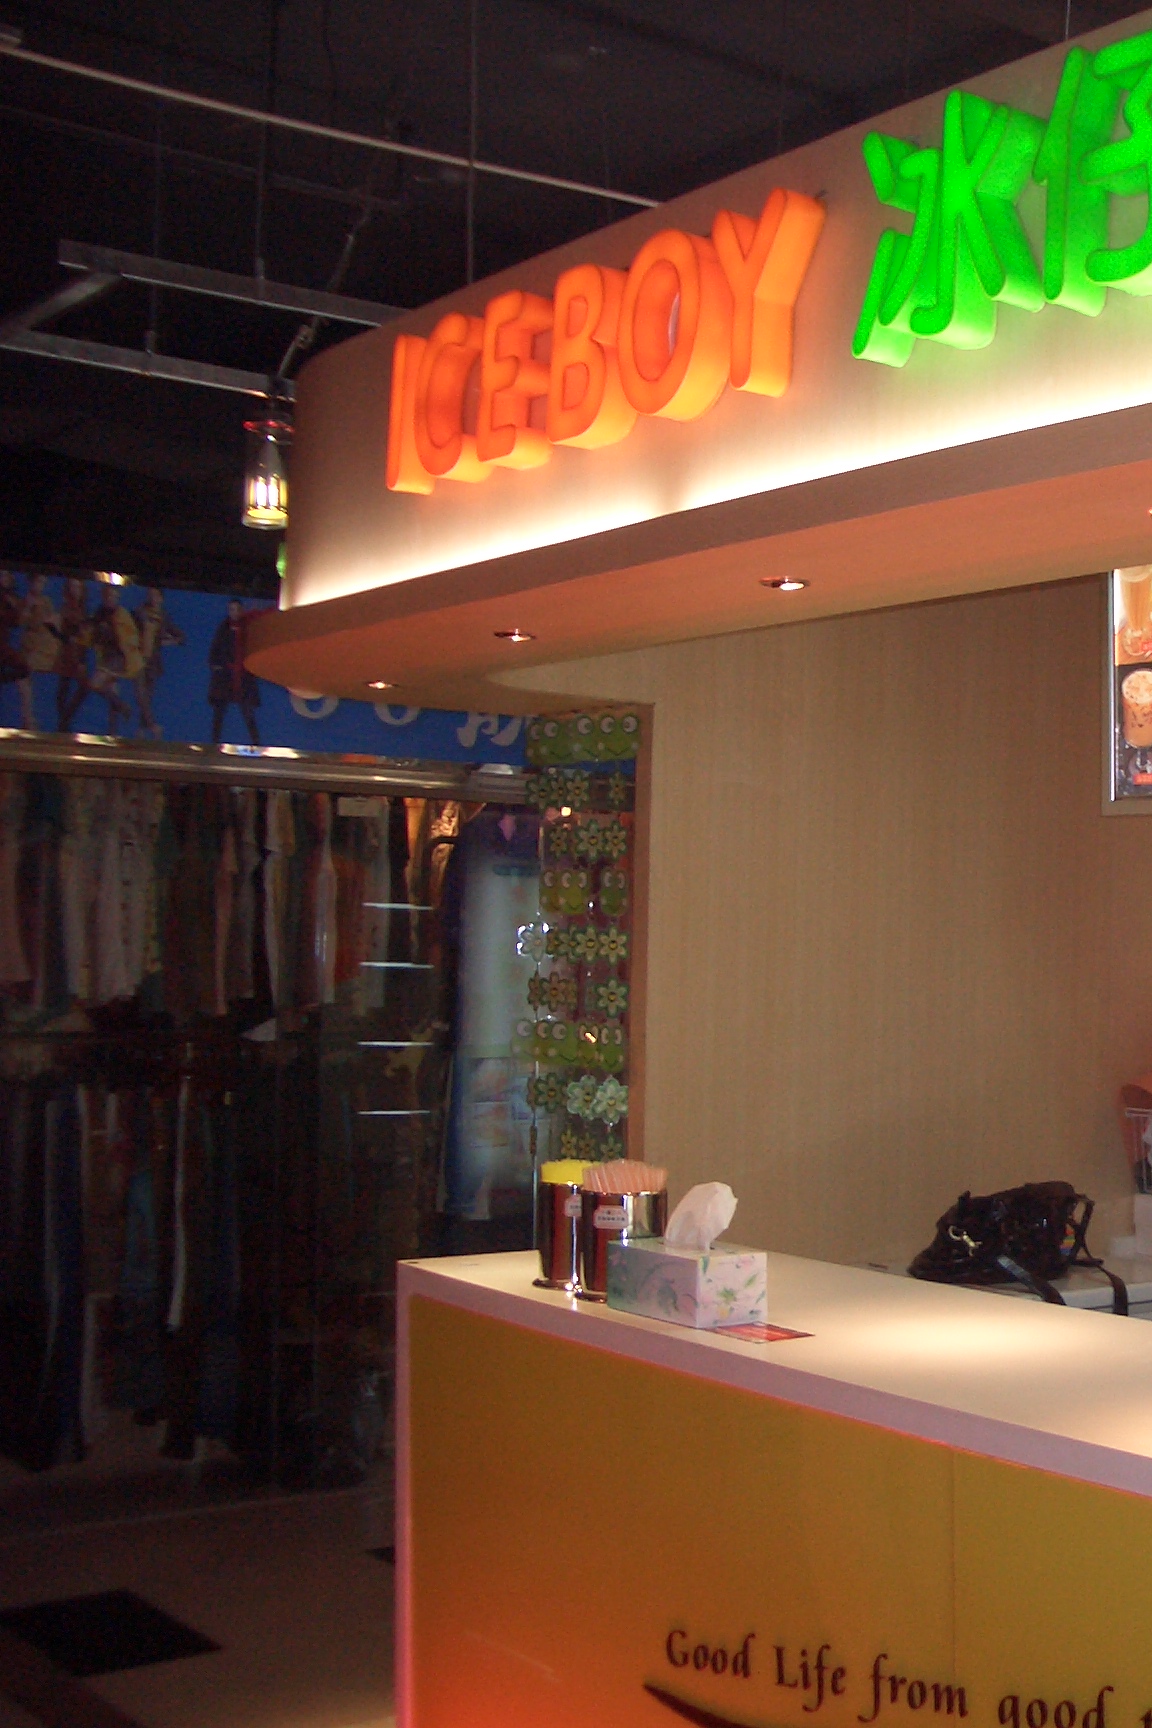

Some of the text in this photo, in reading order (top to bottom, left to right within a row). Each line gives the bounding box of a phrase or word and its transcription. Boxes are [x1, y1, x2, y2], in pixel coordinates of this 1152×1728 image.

[386, 187, 825, 496] ICEBOY
[666, 1629, 756, 1679] Good
[773, 1643, 847, 1713] Life
[858, 1653, 968, 1723] from
